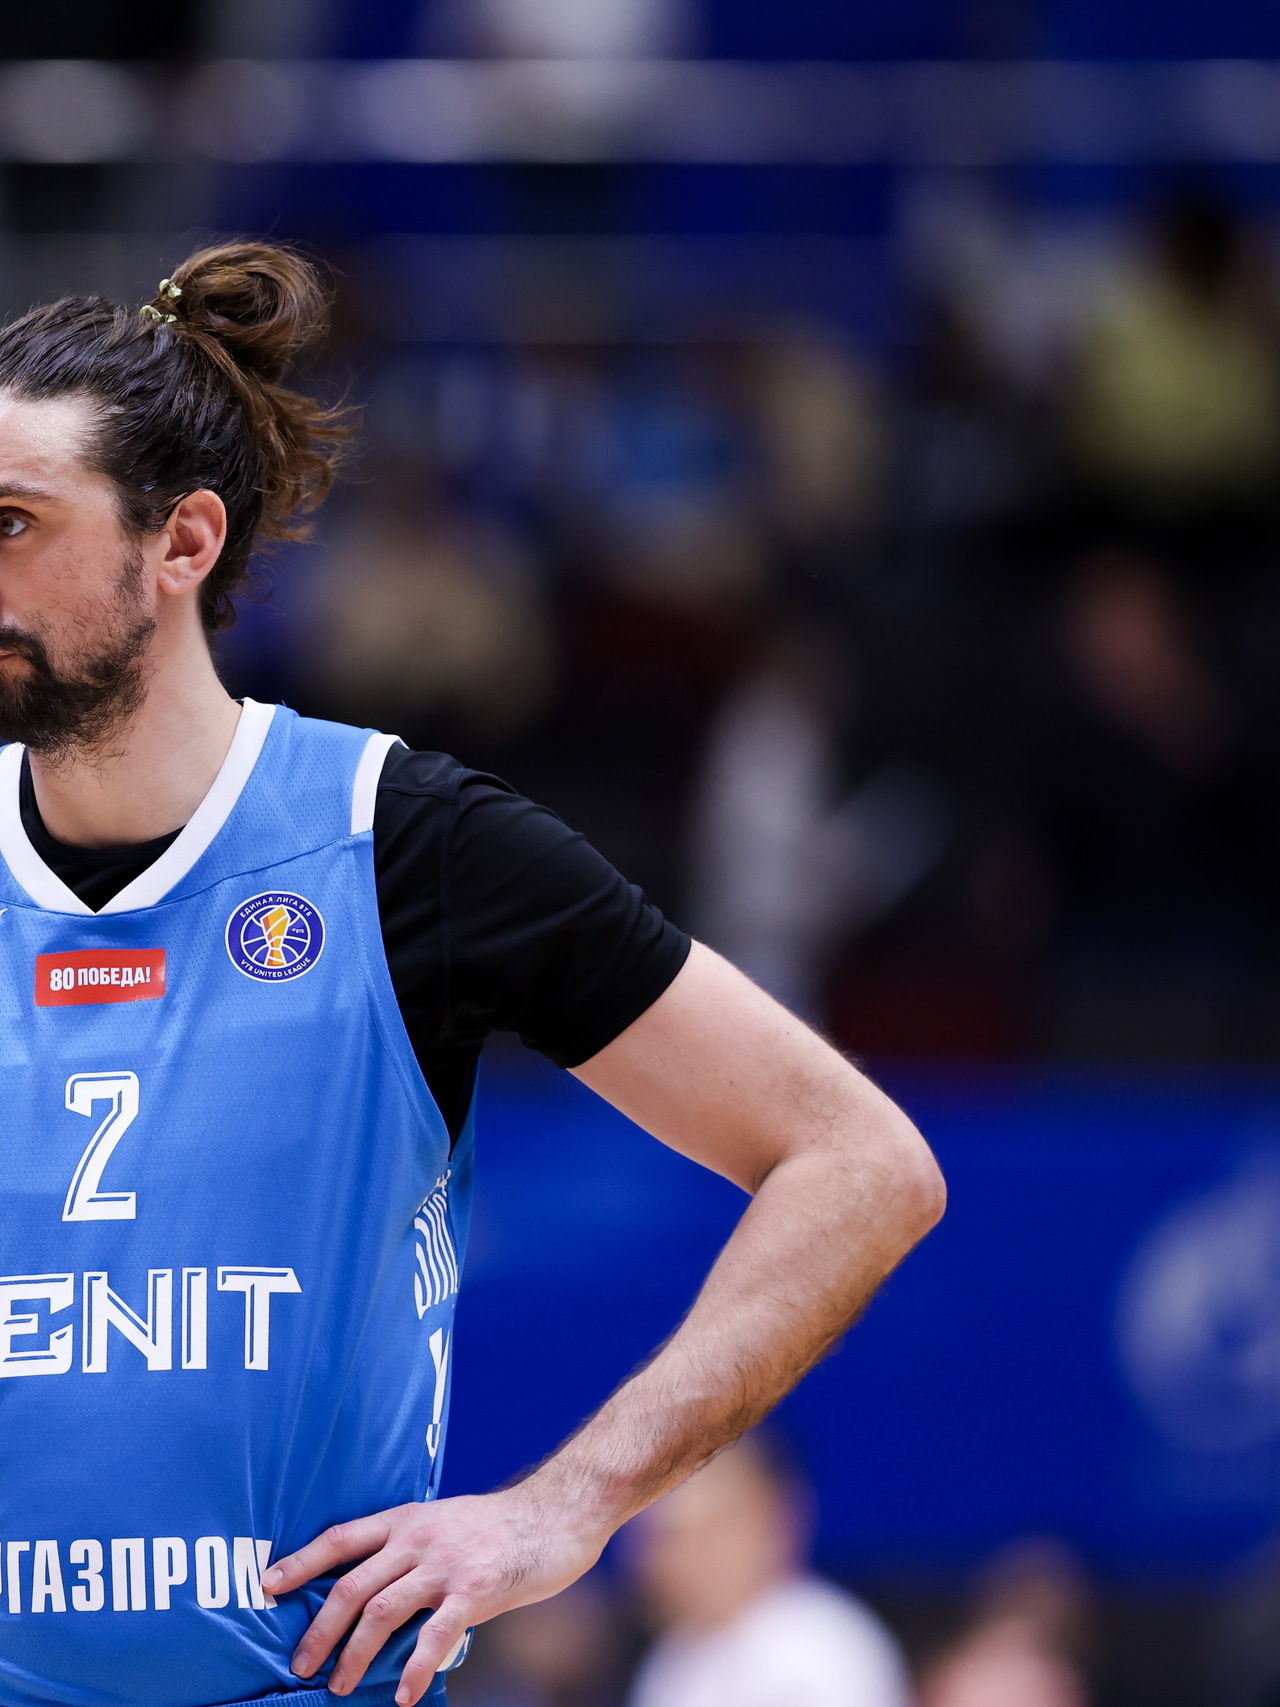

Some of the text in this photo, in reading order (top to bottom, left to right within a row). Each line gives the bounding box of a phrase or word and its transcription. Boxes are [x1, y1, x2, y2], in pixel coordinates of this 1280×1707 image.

[239, 896, 273, 918] ЕДИНАЯ
[299, 904, 312, 917] ВТБ
[49, 966, 151, 992] 80 ПОБЕДА!
[240, 957, 311, 978] VTB UNITED LEAGUE
[62, 1071, 139, 1222] 2
